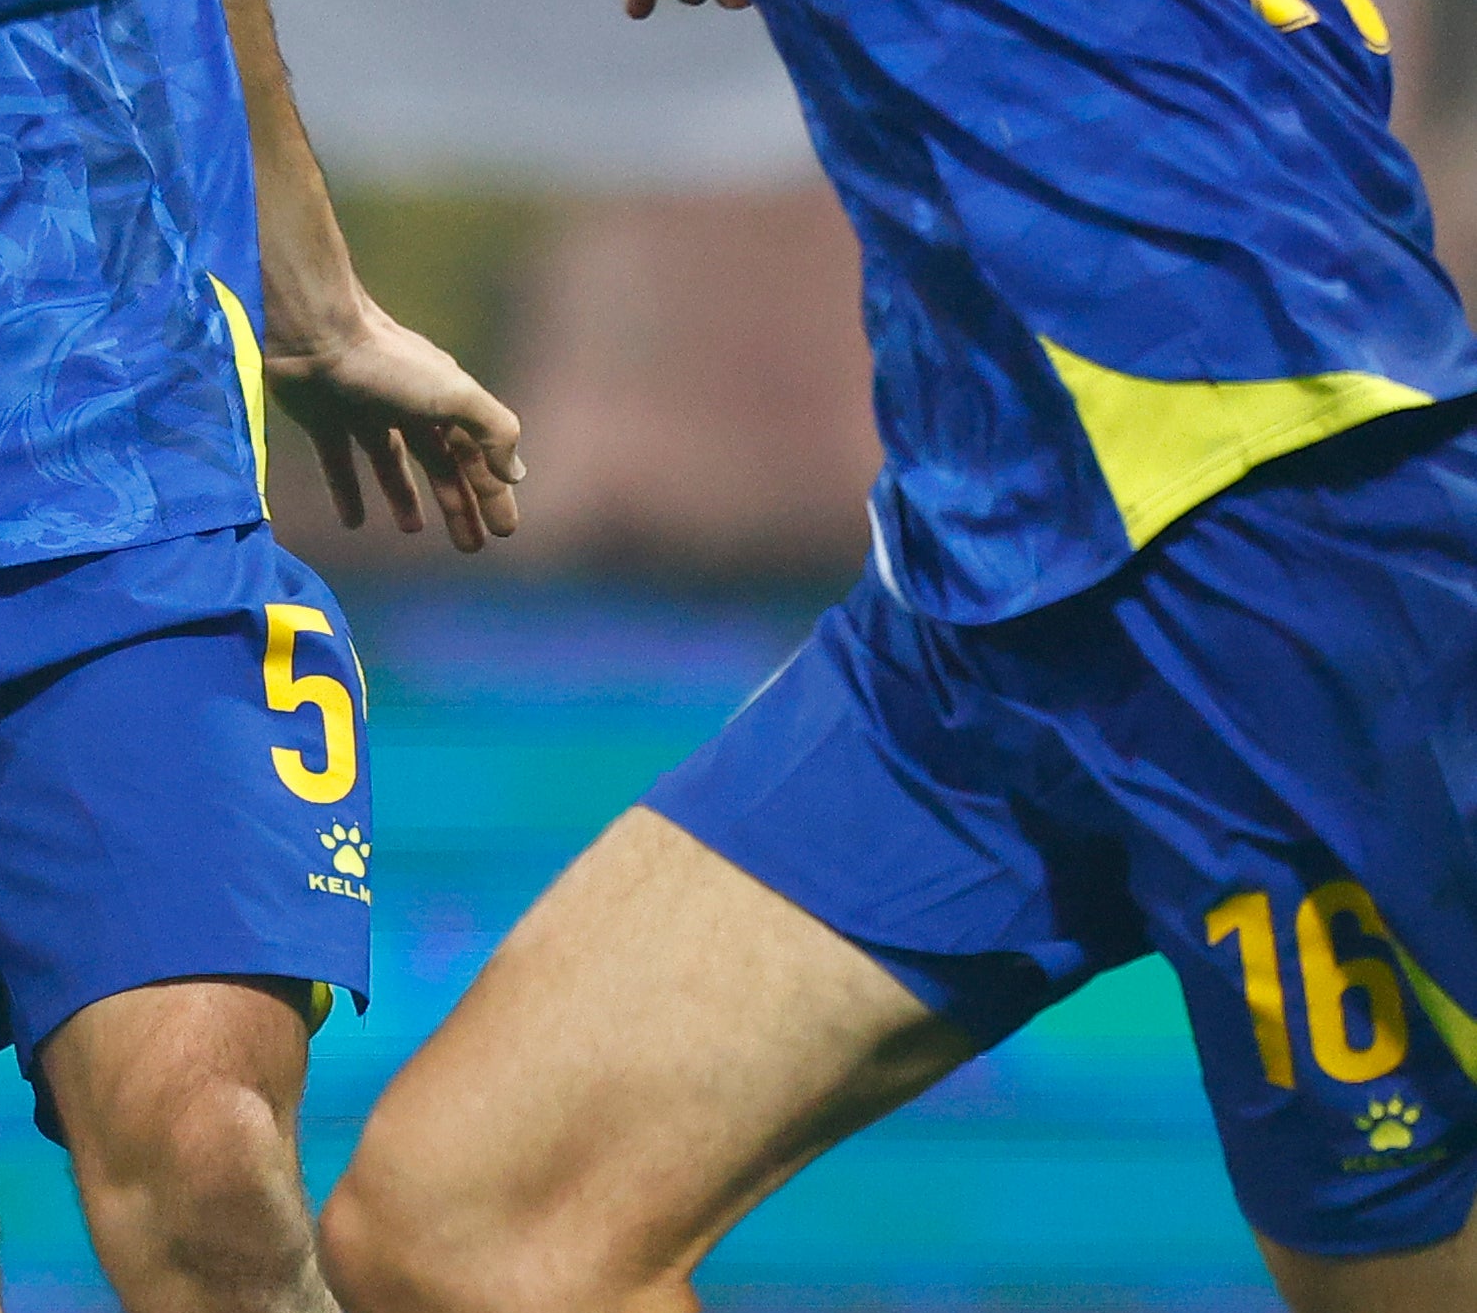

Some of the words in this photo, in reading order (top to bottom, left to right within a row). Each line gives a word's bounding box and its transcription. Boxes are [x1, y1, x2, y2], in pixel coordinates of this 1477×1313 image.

[263, 603, 359, 804] 5
[307, 873, 373, 907] KELM
[1204, 880, 1409, 1089] 16
